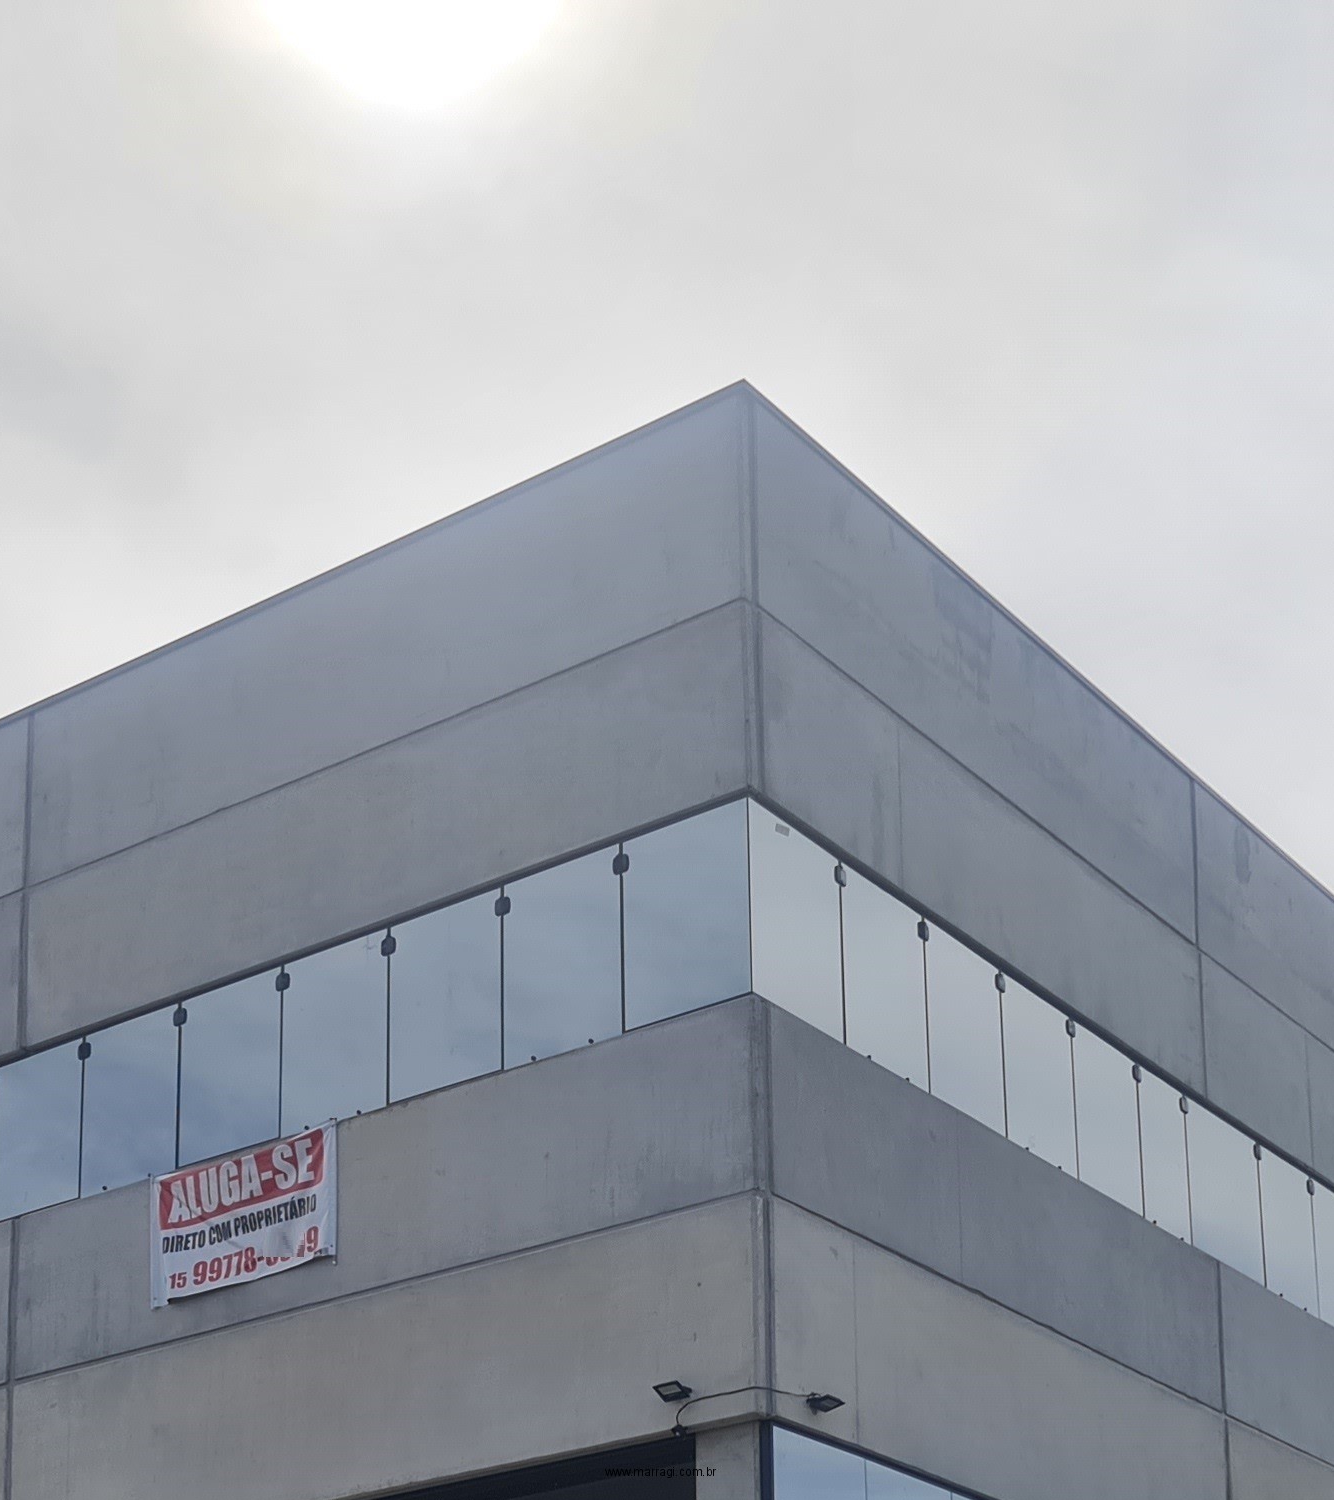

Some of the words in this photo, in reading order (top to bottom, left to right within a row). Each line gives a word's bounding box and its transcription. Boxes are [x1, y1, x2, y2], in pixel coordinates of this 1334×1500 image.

[167, 1138, 316, 1224] ALUGA-SE
[162, 1229, 206, 1254] DIRETO
[208, 1221, 232, 1246] COM
[234, 1193, 317, 1237] PROPRIETÁRIO
[169, 1271, 187, 1289] 15
[192, 1225, 320, 1286] 99778-9
